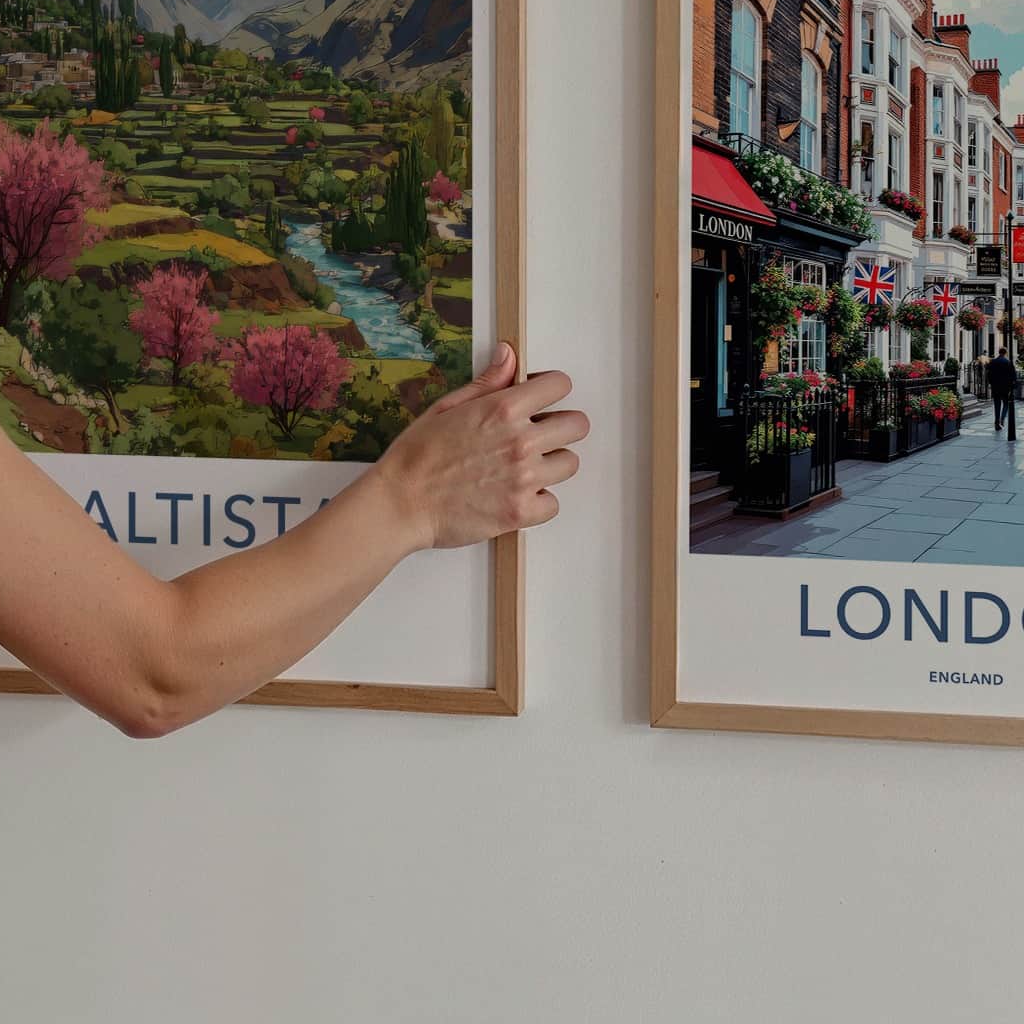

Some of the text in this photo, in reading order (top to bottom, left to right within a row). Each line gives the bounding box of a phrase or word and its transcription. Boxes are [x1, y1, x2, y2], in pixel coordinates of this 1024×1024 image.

[698, 213, 754, 242] LONDON
[84, 489, 329, 550] ALTIST
[799, 583, 1024, 645] LOND
[929, 670, 1004, 686] ENGLAND
